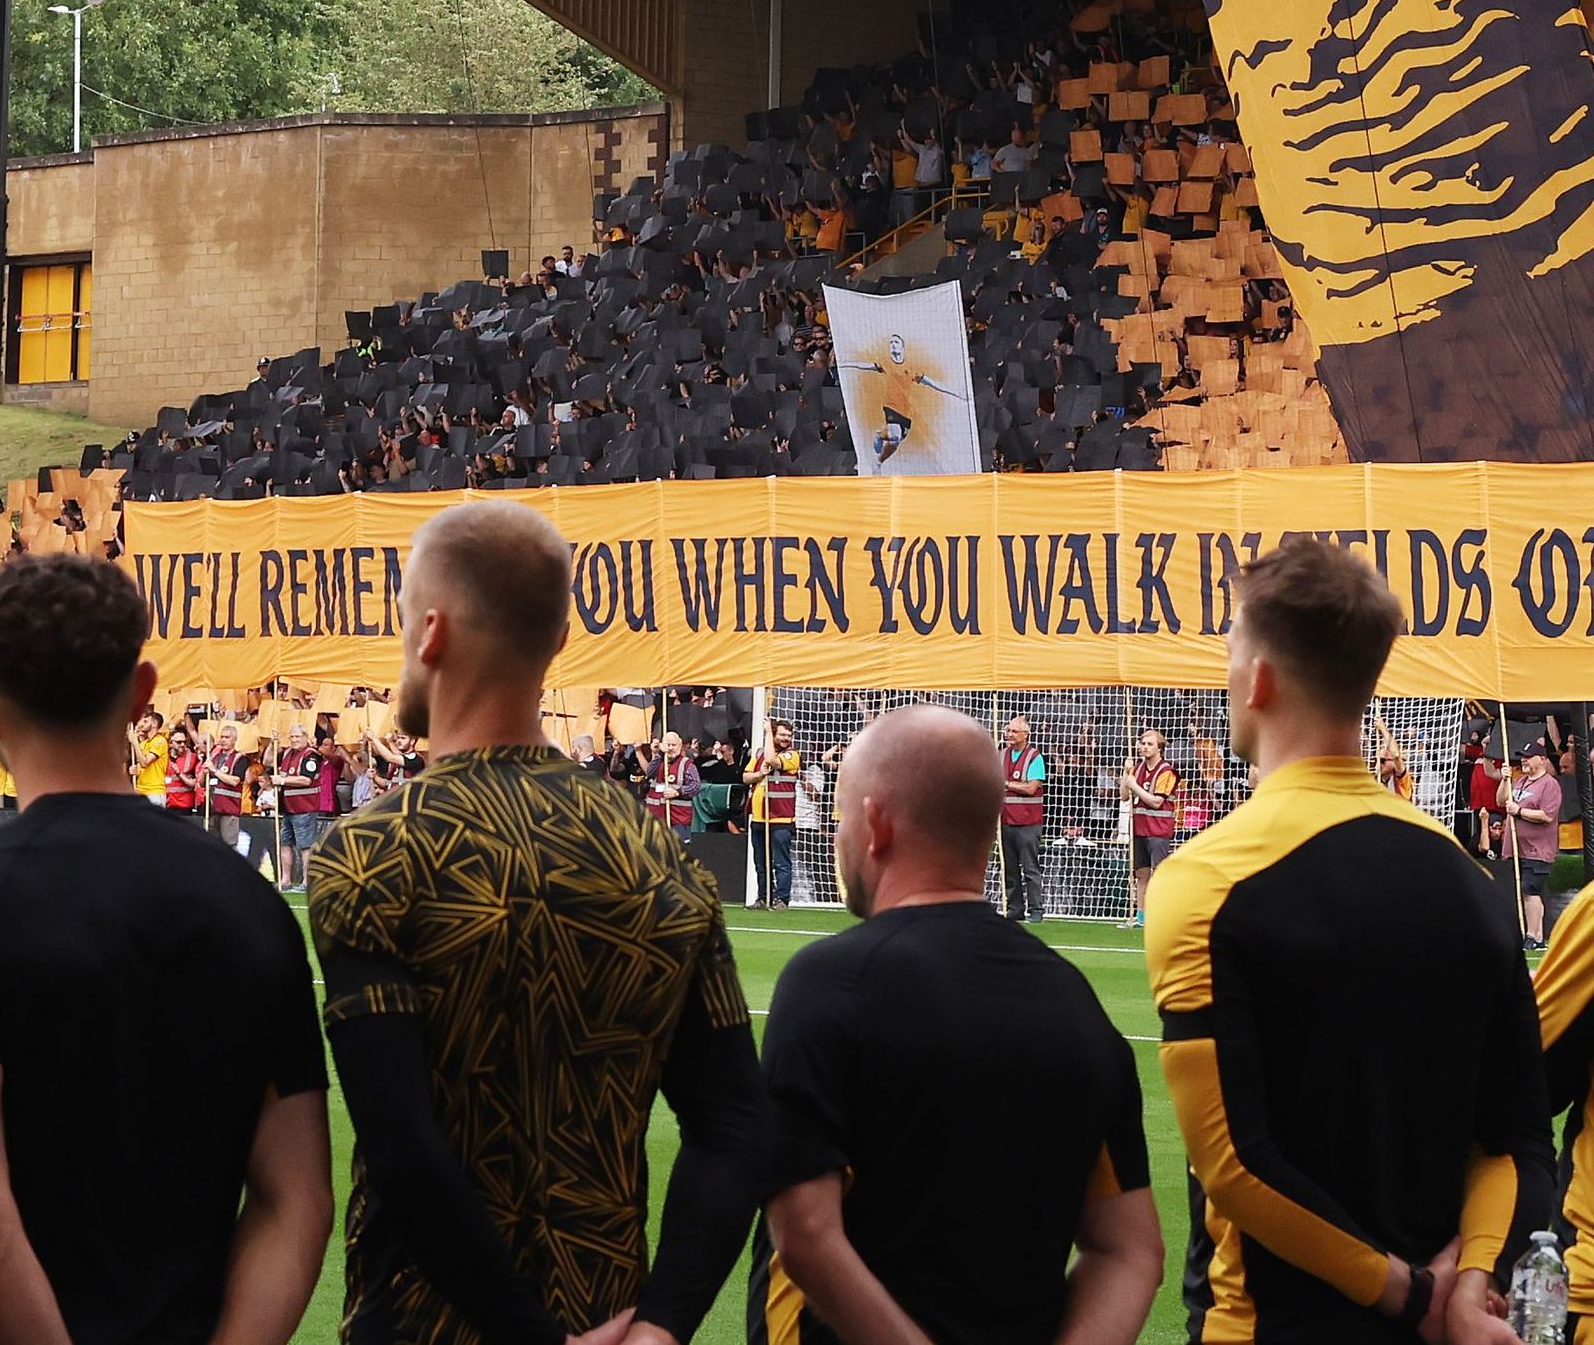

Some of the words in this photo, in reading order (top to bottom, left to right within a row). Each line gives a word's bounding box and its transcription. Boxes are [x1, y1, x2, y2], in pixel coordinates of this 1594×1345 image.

[259, 547, 405, 637] REMEM
[669, 536, 850, 634] WHEN
[864, 535, 982, 635] YOU
[997, 533, 1181, 636] WALK
